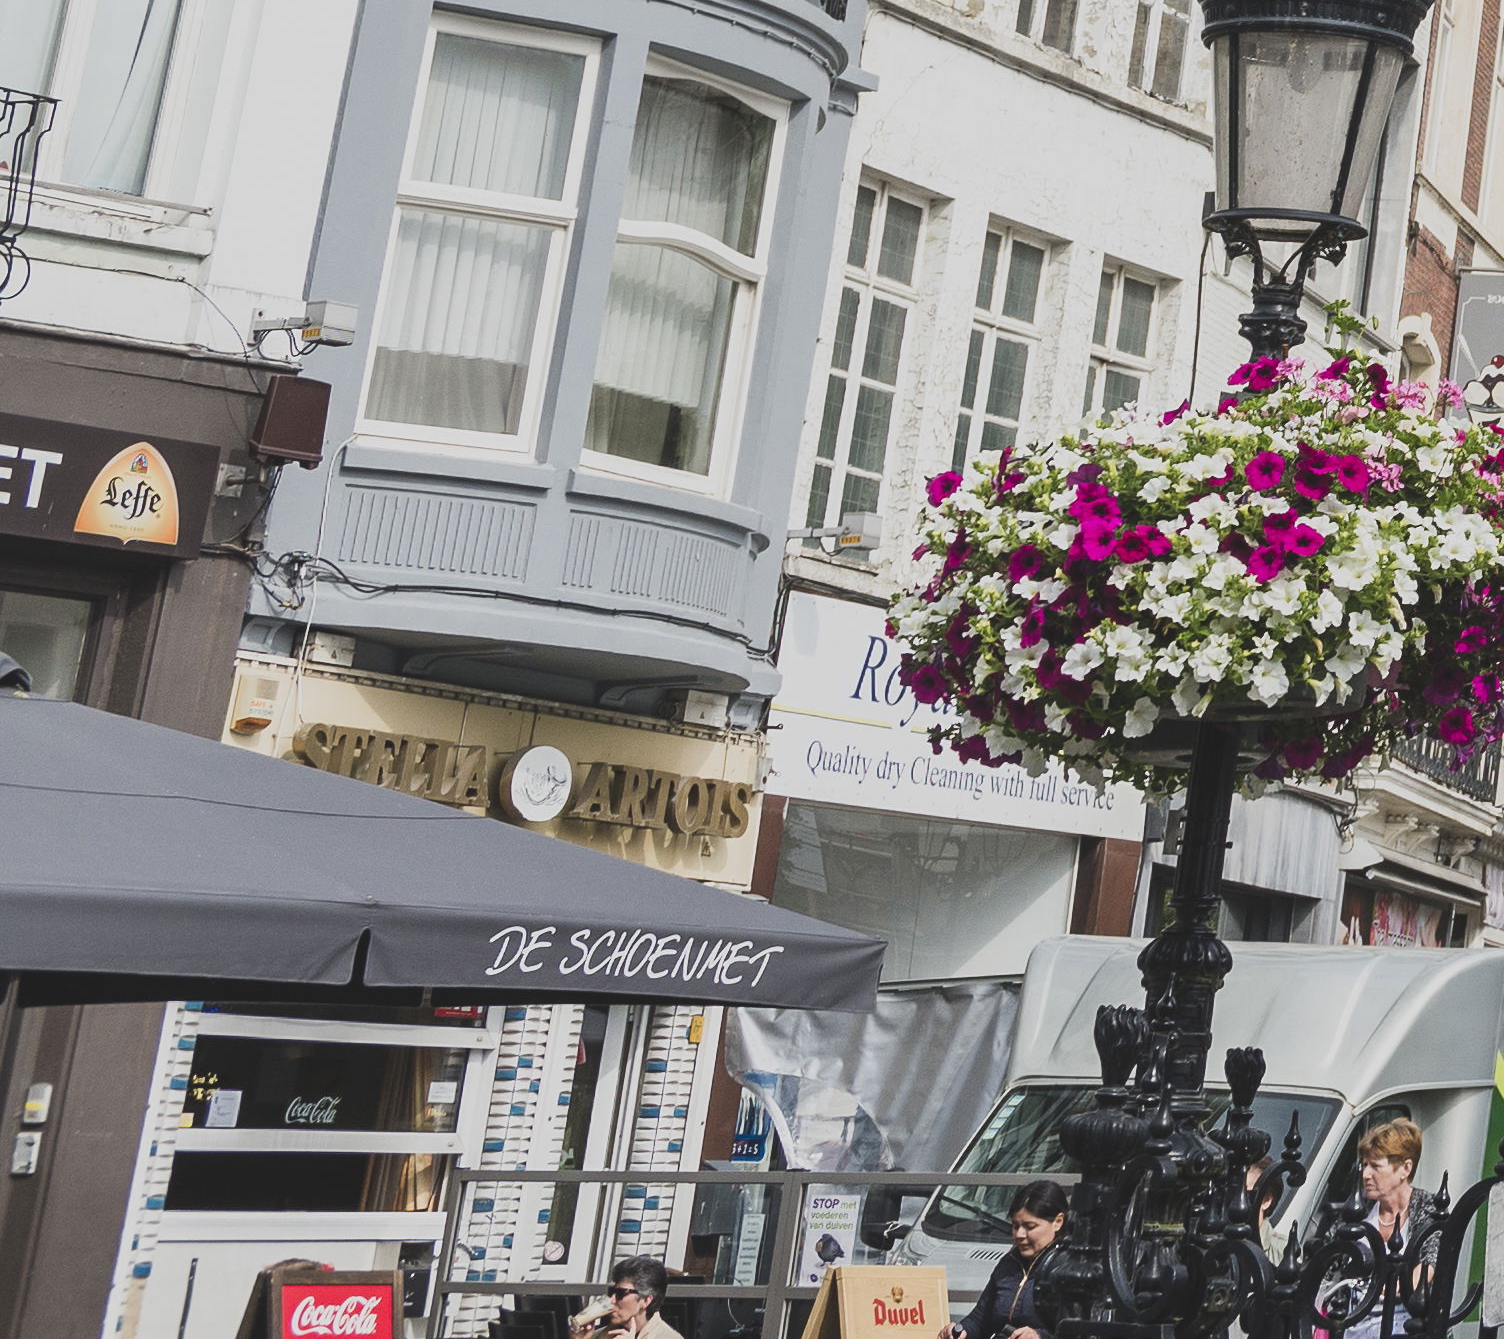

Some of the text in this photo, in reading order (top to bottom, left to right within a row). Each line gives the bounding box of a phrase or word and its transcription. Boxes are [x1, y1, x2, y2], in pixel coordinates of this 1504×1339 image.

[100, 475, 165, 521] Leffe
[292, 721, 753, 839] STELLA ARTOIS
[806, 740, 871, 784] Quality
[876, 751, 904, 789] dry
[910, 755, 983, 800] Cleaning
[989, 768, 1024, 799] with
[1029, 775, 1058, 804] full
[485, 926, 785, 988] DE SCHOENMET
[810, 1209, 849, 1221] voederen
[812, 1197, 857, 1210] STOP met
[872, 1298, 925, 1326] Duvel
